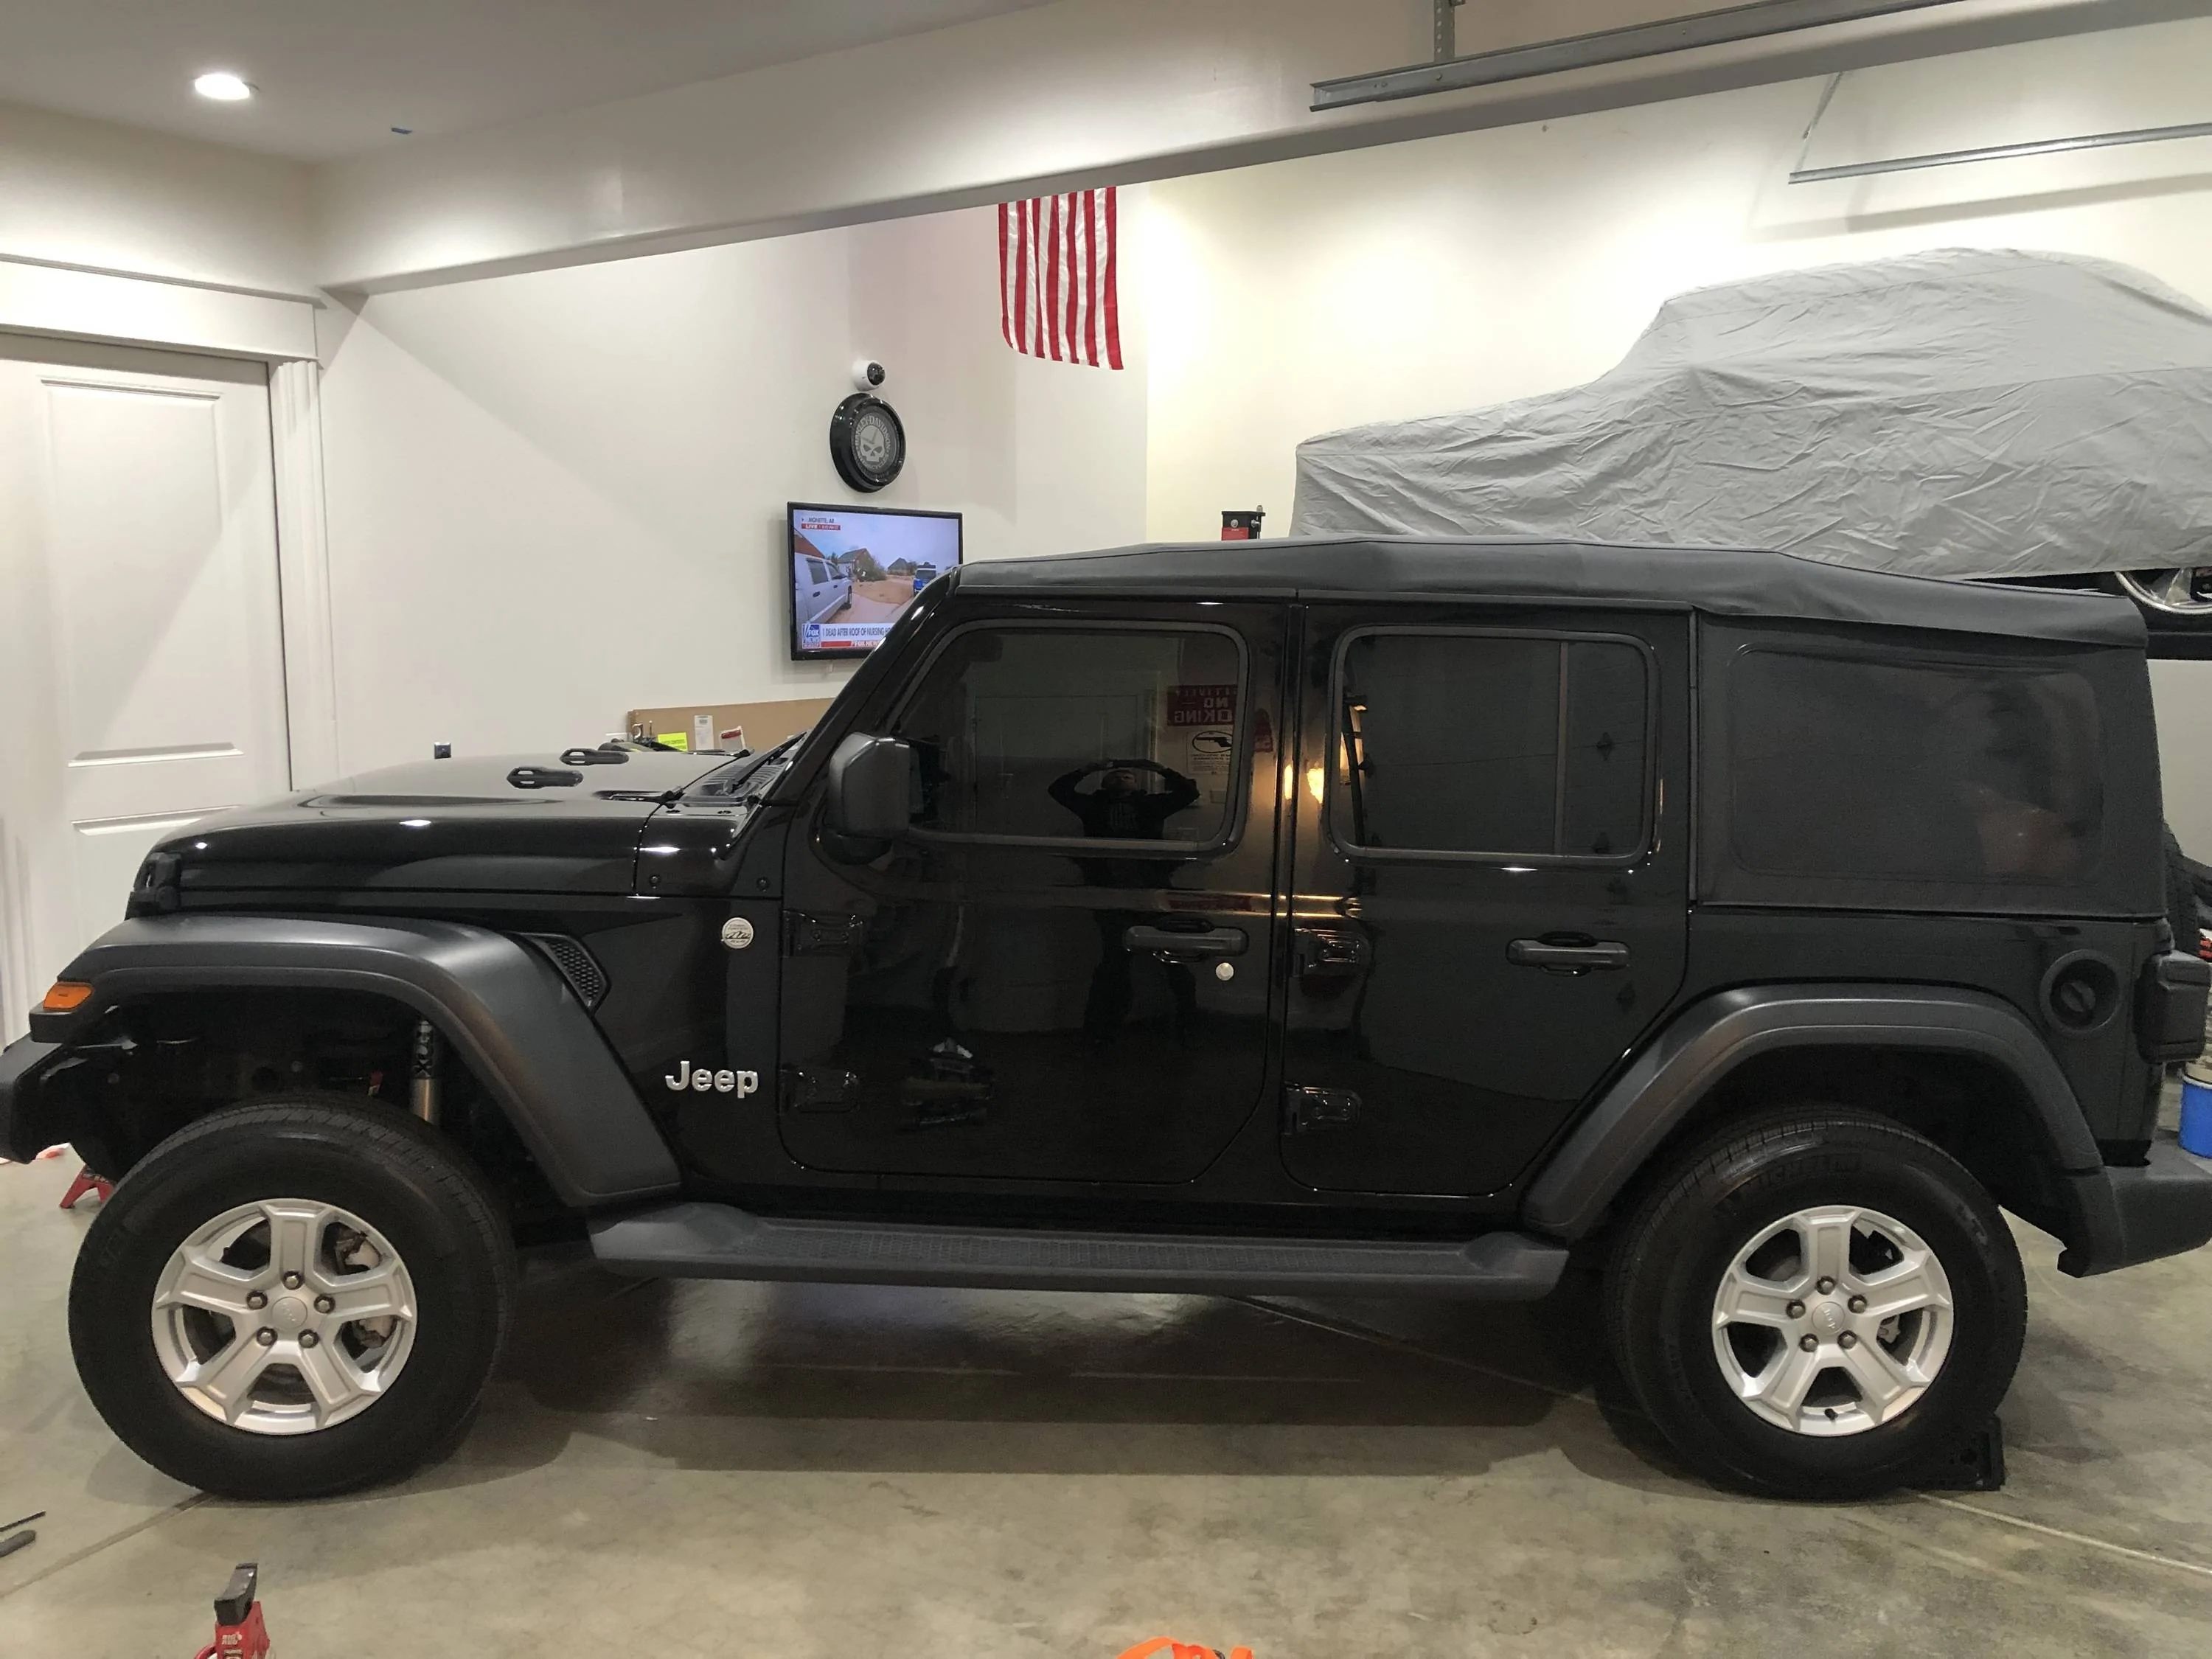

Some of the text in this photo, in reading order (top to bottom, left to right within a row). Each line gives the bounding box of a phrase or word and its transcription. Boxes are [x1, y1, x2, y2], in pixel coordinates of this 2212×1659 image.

[855, 415, 891, 449] HARLEY-DAVIDSON
[807, 628, 820, 637] FOX
[826, 628, 836, 636] DEAD
[837, 628, 848, 636] AFTER
[849, 627, 860, 636] ROOF
[861, 627, 867, 636] OF
[867, 627, 884, 636] NURSING
[665, 1060, 759, 1099] Jeep
